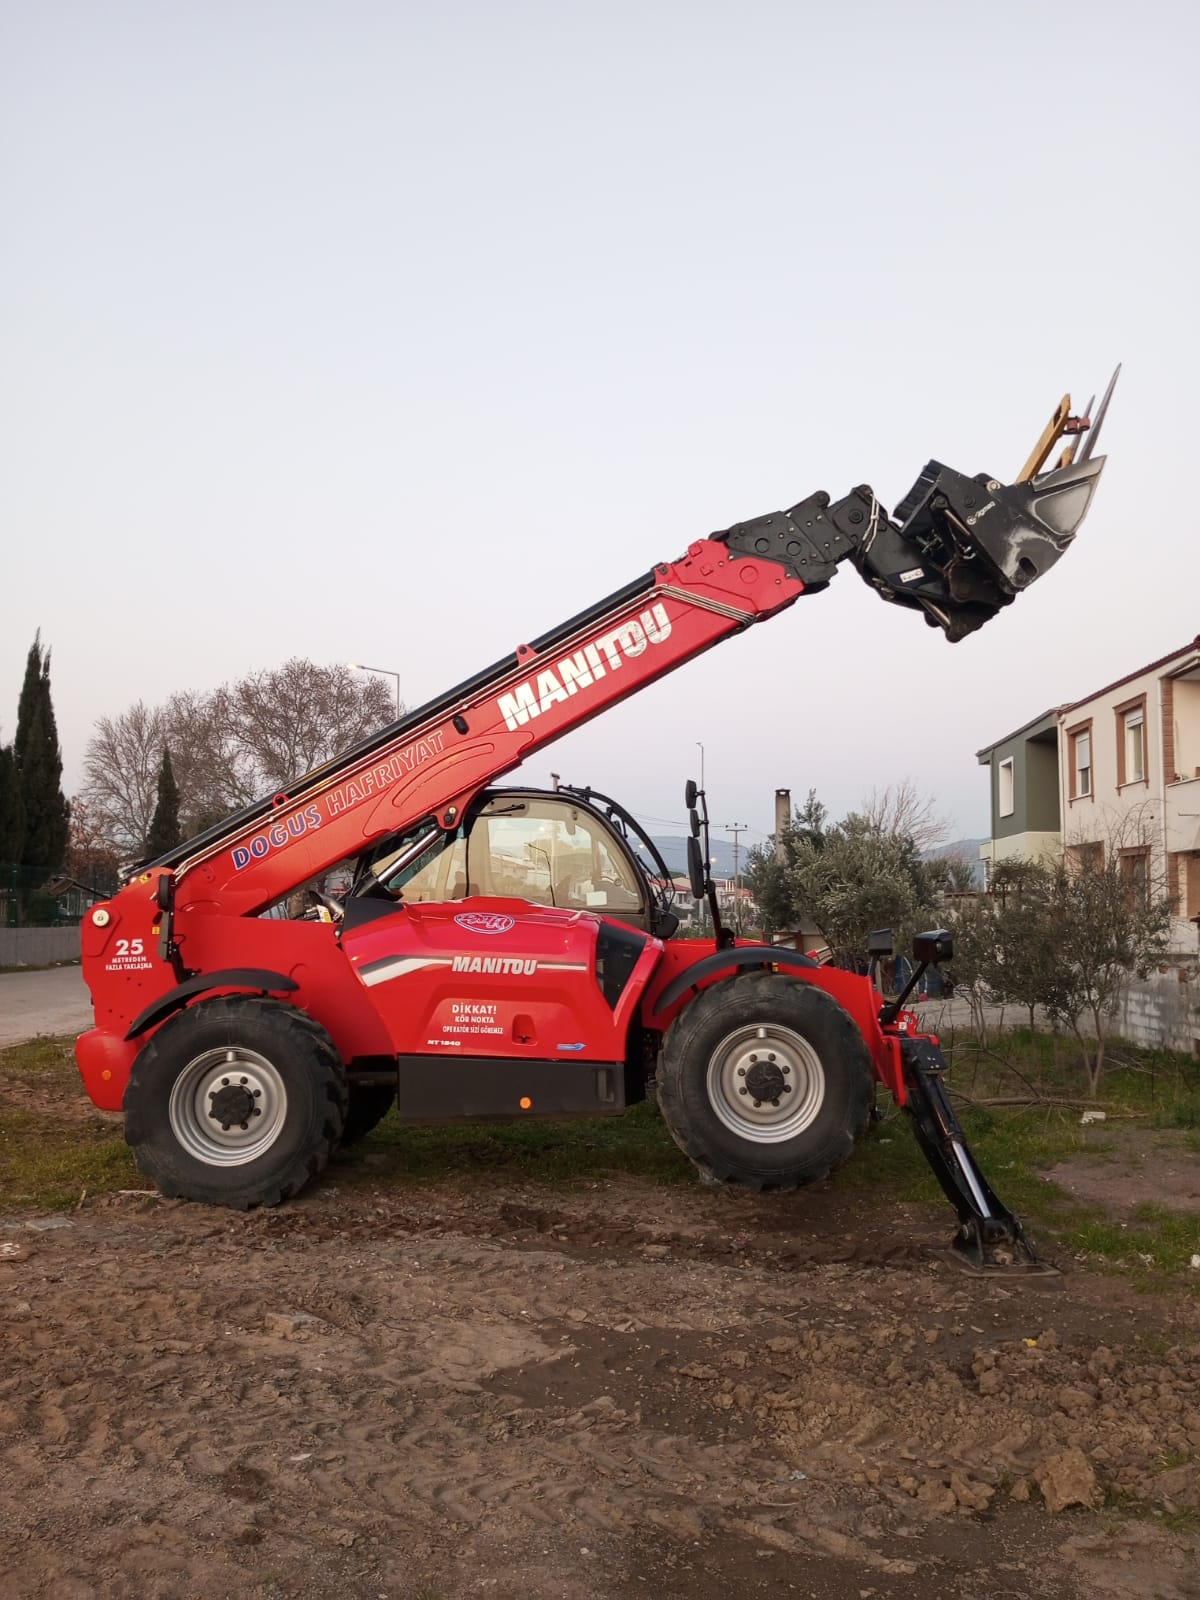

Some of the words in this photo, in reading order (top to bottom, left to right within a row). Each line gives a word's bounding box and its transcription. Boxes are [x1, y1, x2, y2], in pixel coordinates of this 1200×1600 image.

[497, 603, 672, 732] MANITOU
[231, 804, 322, 871] DOĞUŞ
[325, 731, 445, 816] HAFRİYAT
[115, 938, 144, 956] 25
[111, 956, 147, 964] METREDEN
[452, 956, 538, 976] MANITOU
[451, 1003, 497, 1014] DİKKAT!
[454, 1014, 470, 1023] KÖR
[471, 1015, 495, 1024] NOKTA
